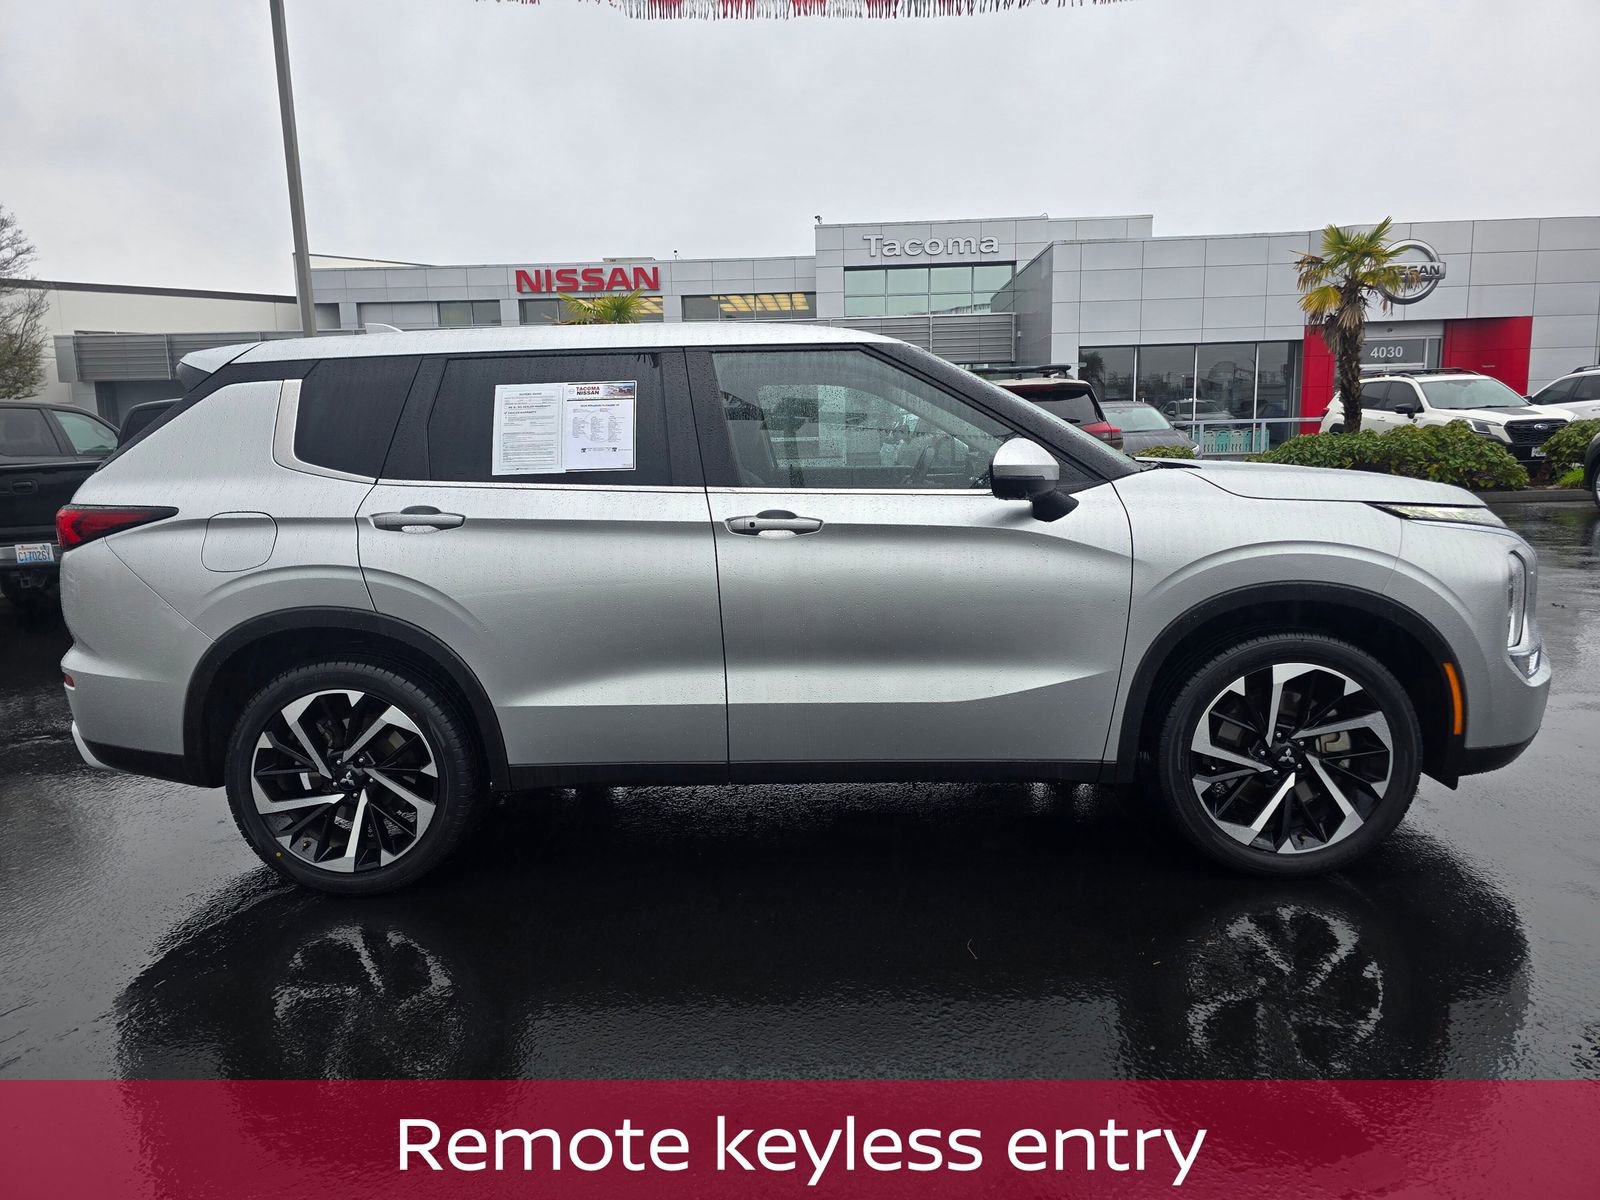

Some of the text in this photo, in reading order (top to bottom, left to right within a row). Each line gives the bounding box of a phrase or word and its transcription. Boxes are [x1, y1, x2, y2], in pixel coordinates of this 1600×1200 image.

[863, 234, 999, 257] Tacoma
[515, 266, 660, 294] NISSAN
[1370, 346, 1403, 359] 4030
